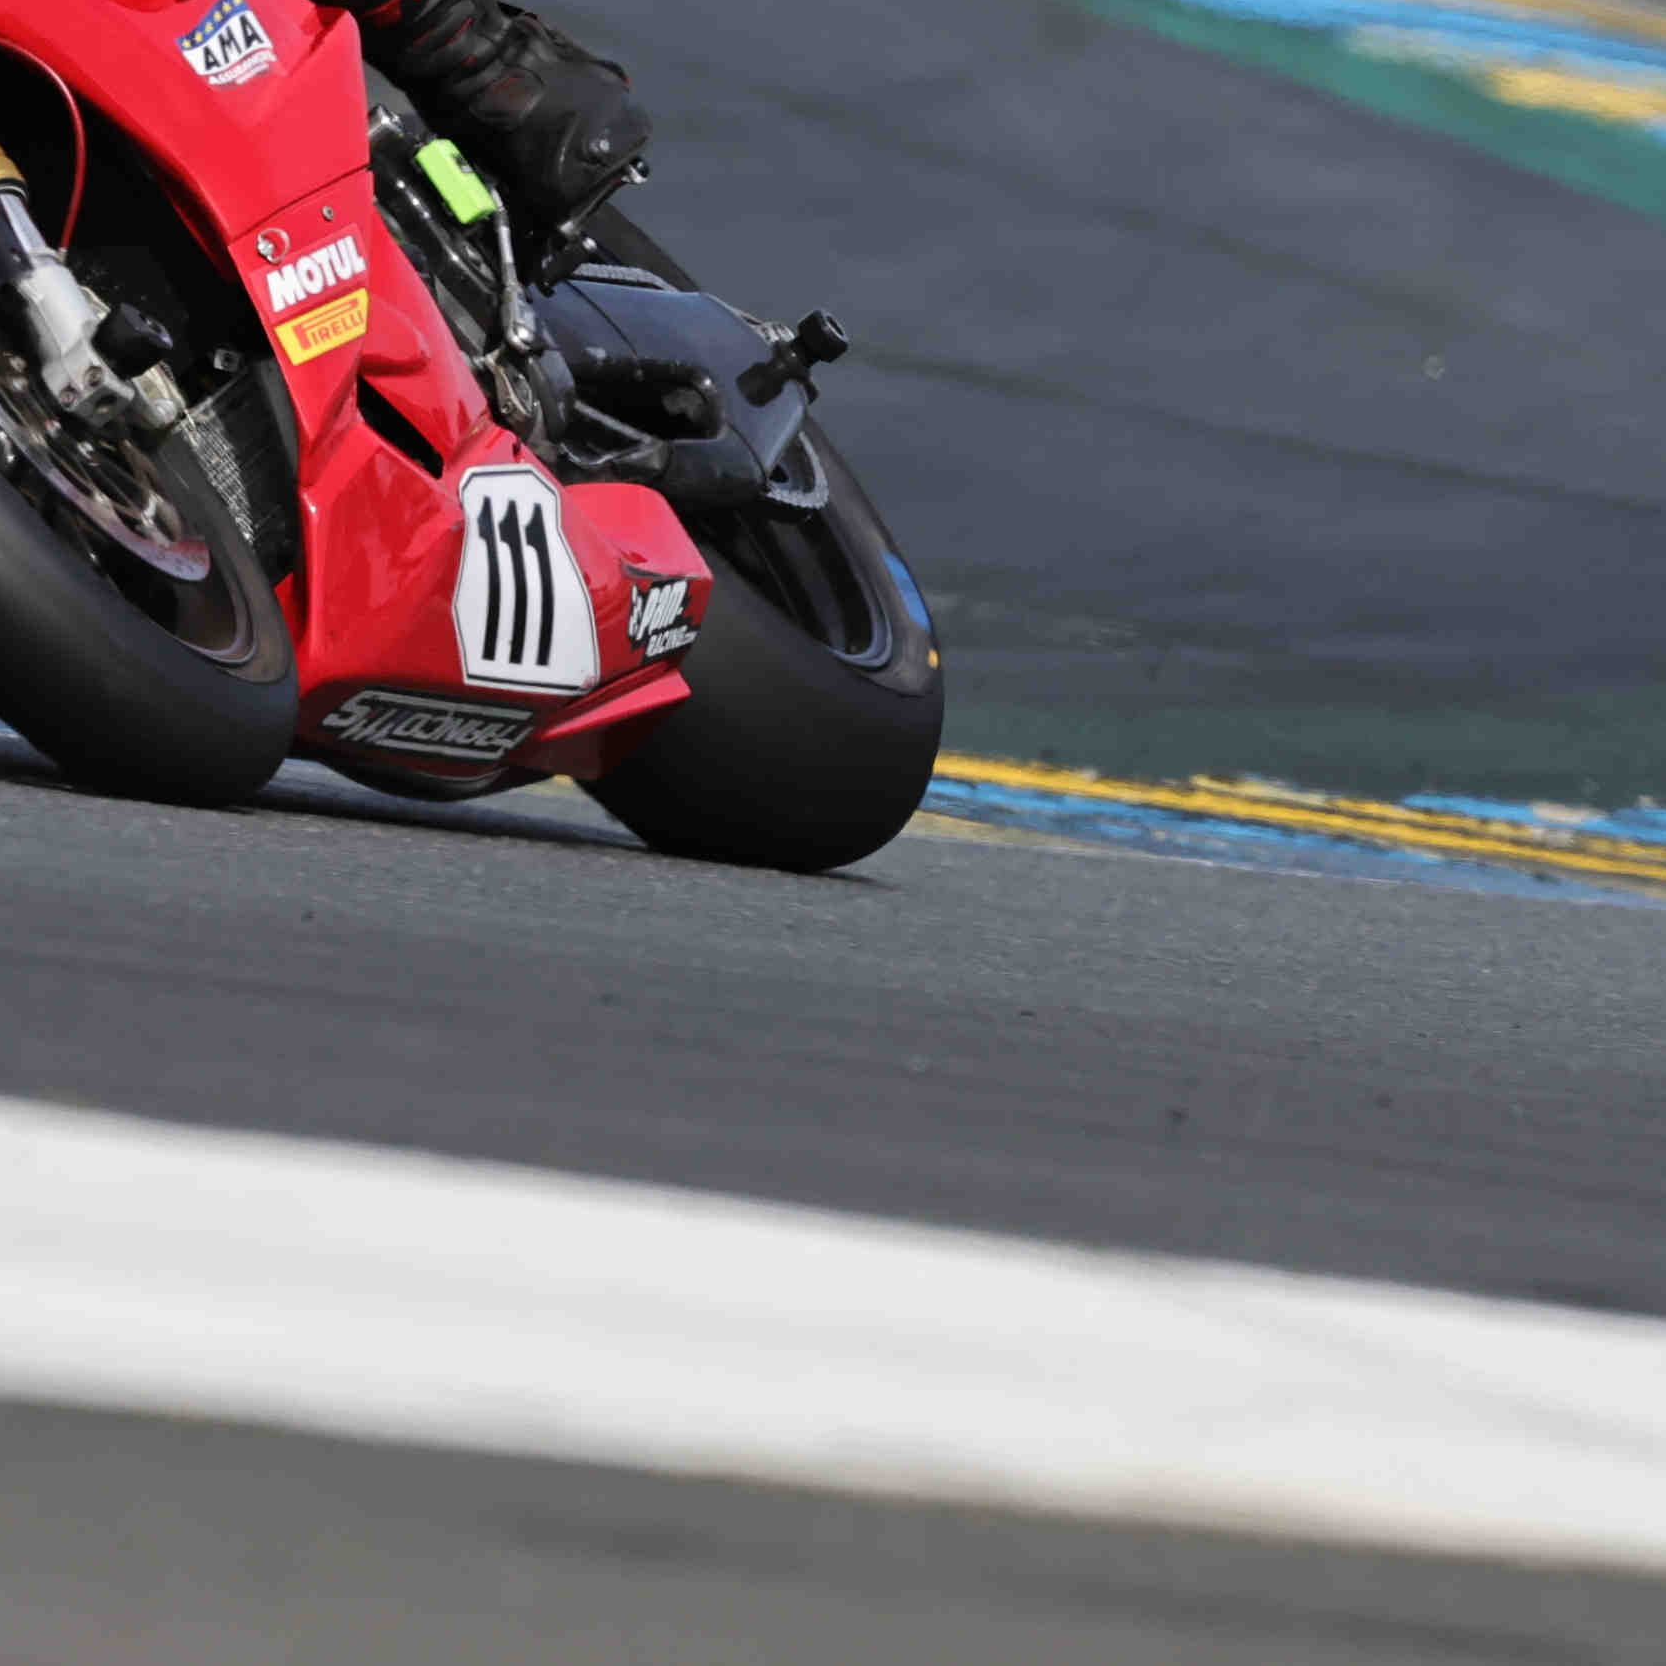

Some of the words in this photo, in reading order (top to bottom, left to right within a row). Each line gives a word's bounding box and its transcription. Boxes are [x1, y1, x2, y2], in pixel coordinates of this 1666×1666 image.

[203, 15, 265, 71] AMA
[266, 234, 367, 313] MOTUL
[292, 297, 366, 352] PIRELLI
[477, 496, 555, 667] 111
